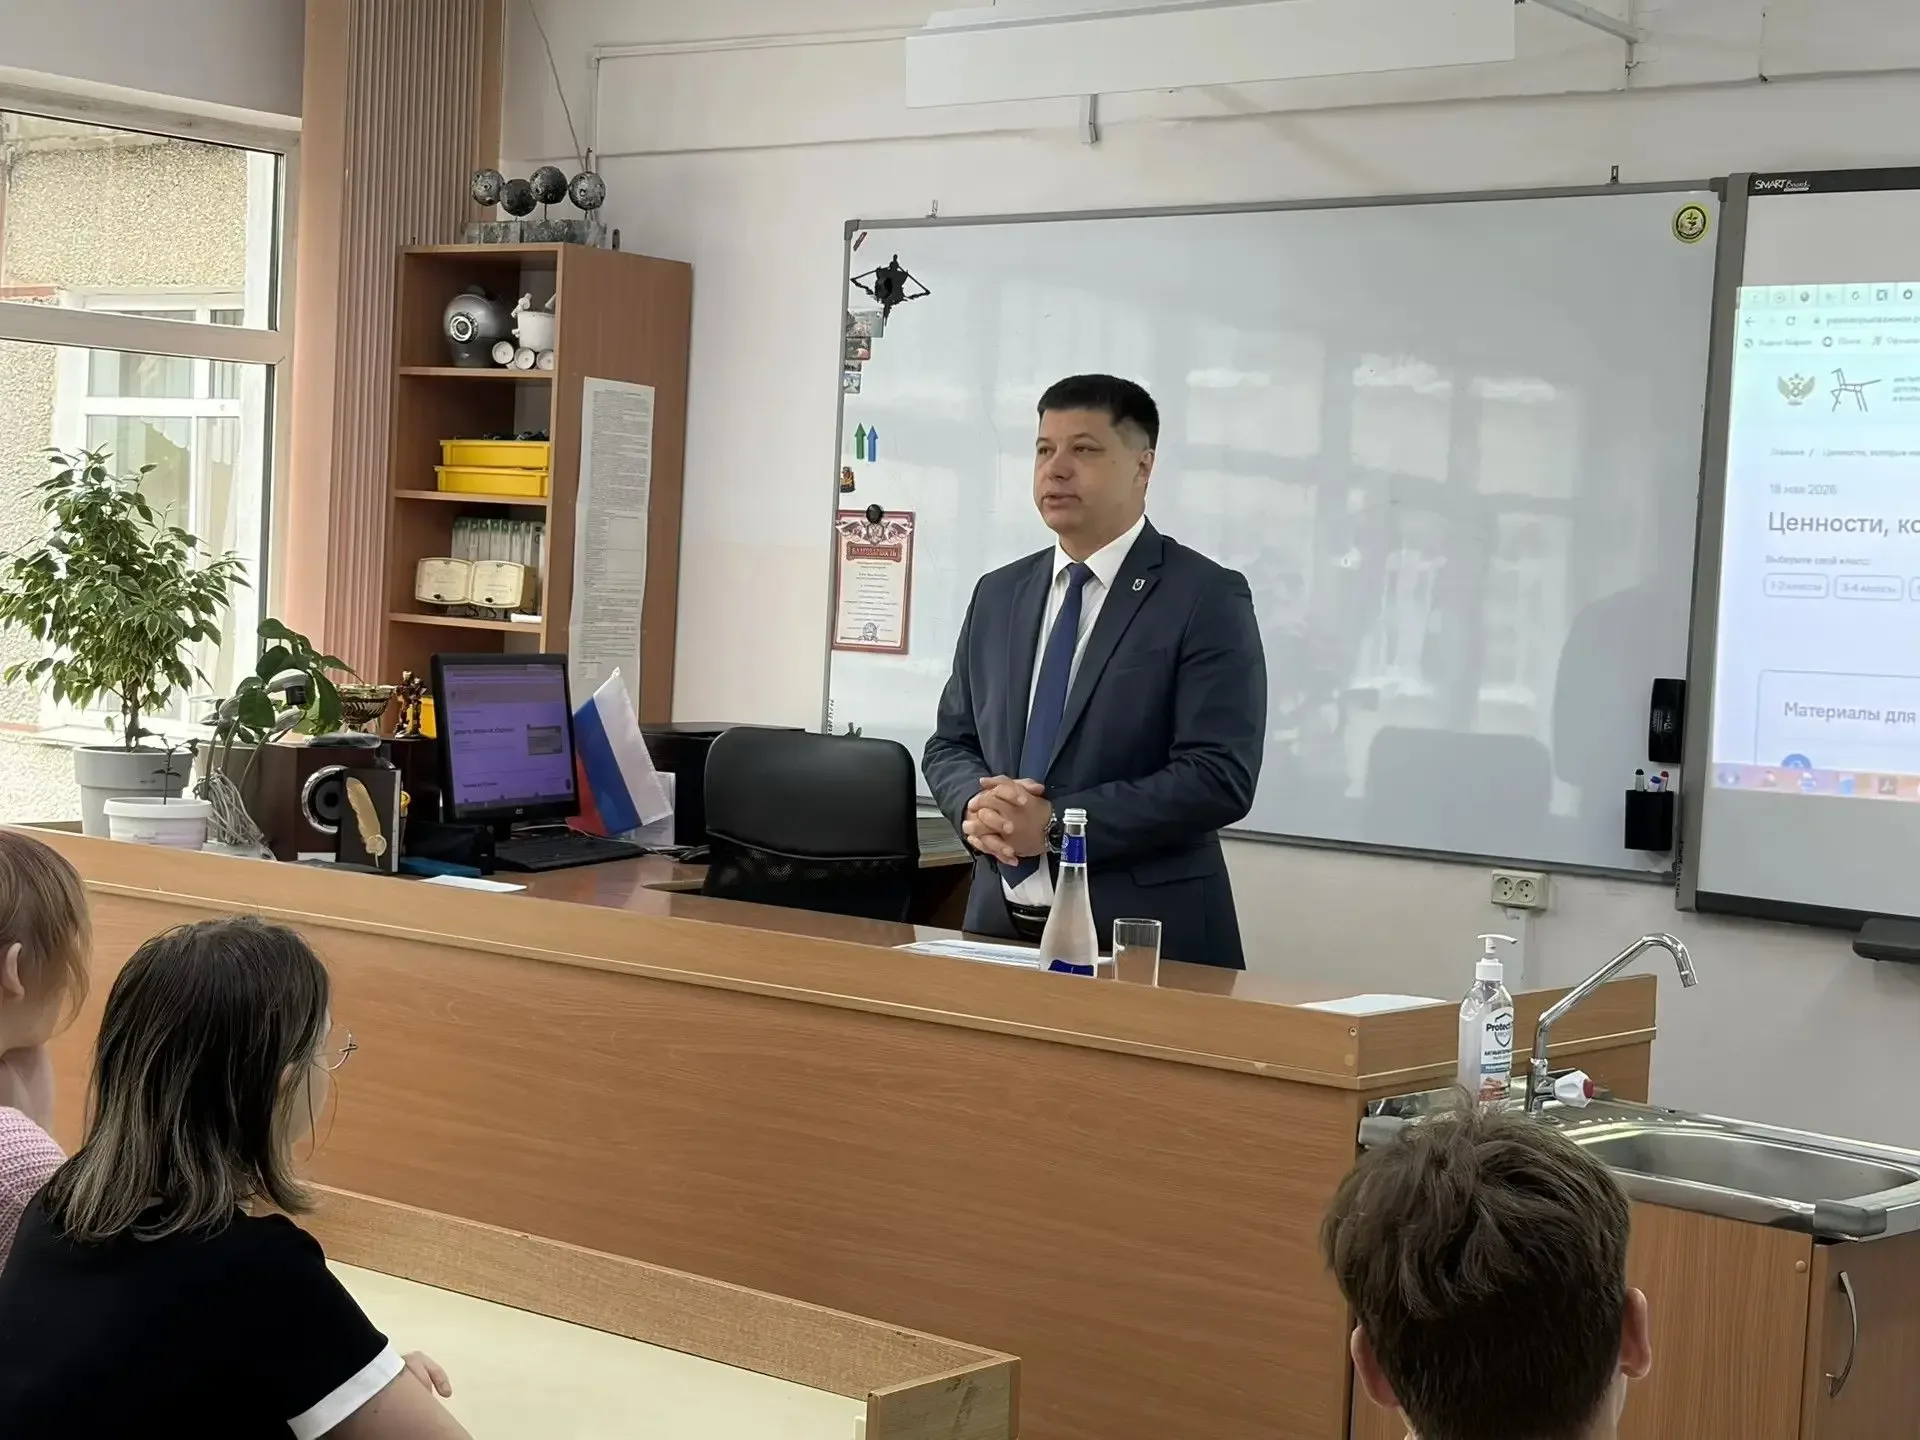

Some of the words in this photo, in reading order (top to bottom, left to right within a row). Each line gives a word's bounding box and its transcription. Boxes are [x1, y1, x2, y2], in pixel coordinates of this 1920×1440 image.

[1755, 179, 1787, 190] SMART
[1768, 511, 1890, 538] Ценности,
[1784, 701, 1881, 722] Материалы
[1884, 710, 1917, 724] для
